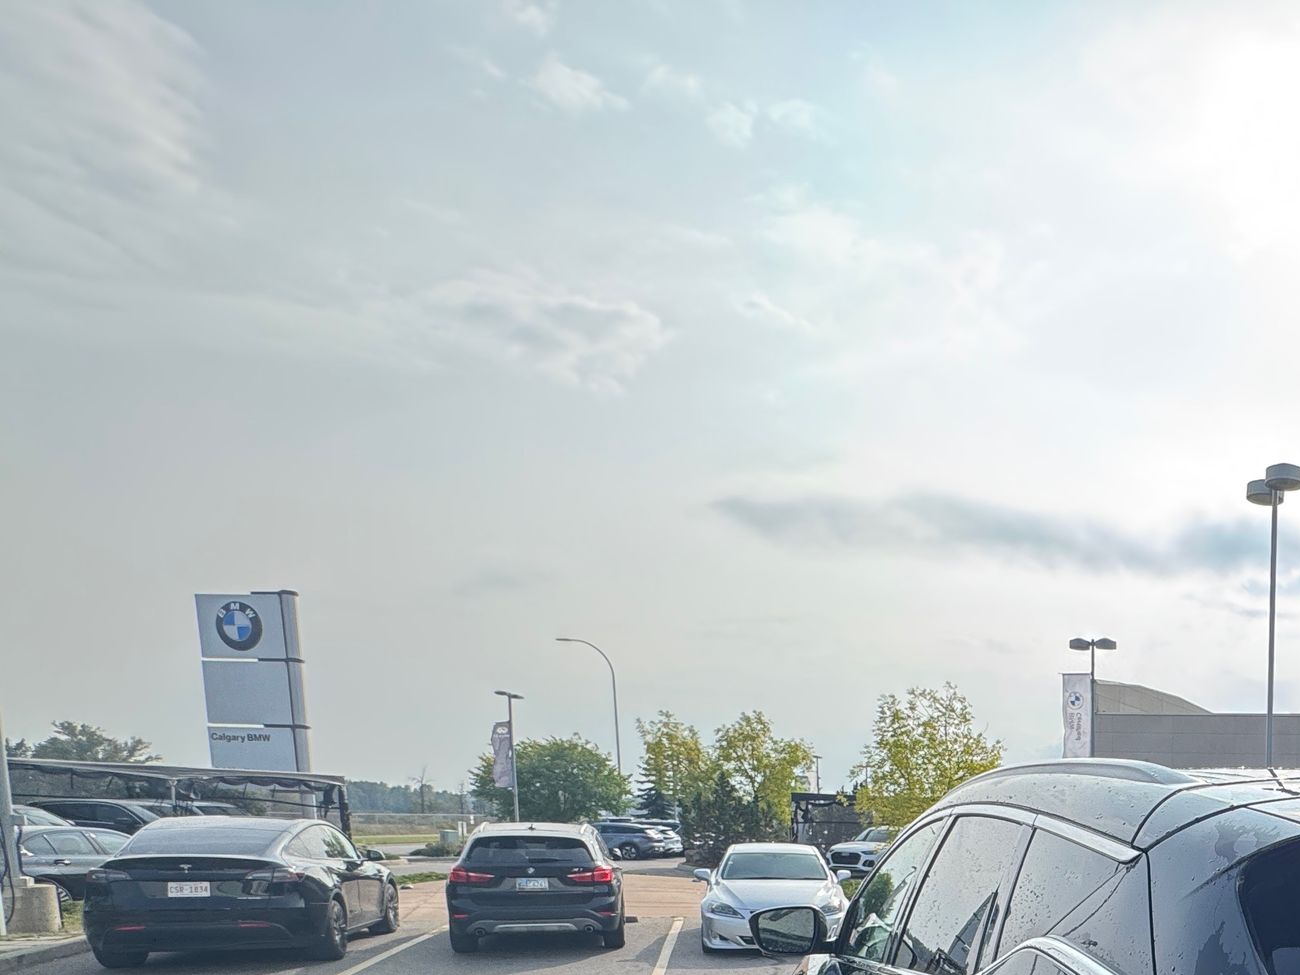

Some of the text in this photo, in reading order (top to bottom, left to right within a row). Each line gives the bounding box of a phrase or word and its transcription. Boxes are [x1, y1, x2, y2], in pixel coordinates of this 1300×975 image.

[218, 602, 256, 619] BMW
[211, 732, 271, 743] Calgary BMW
